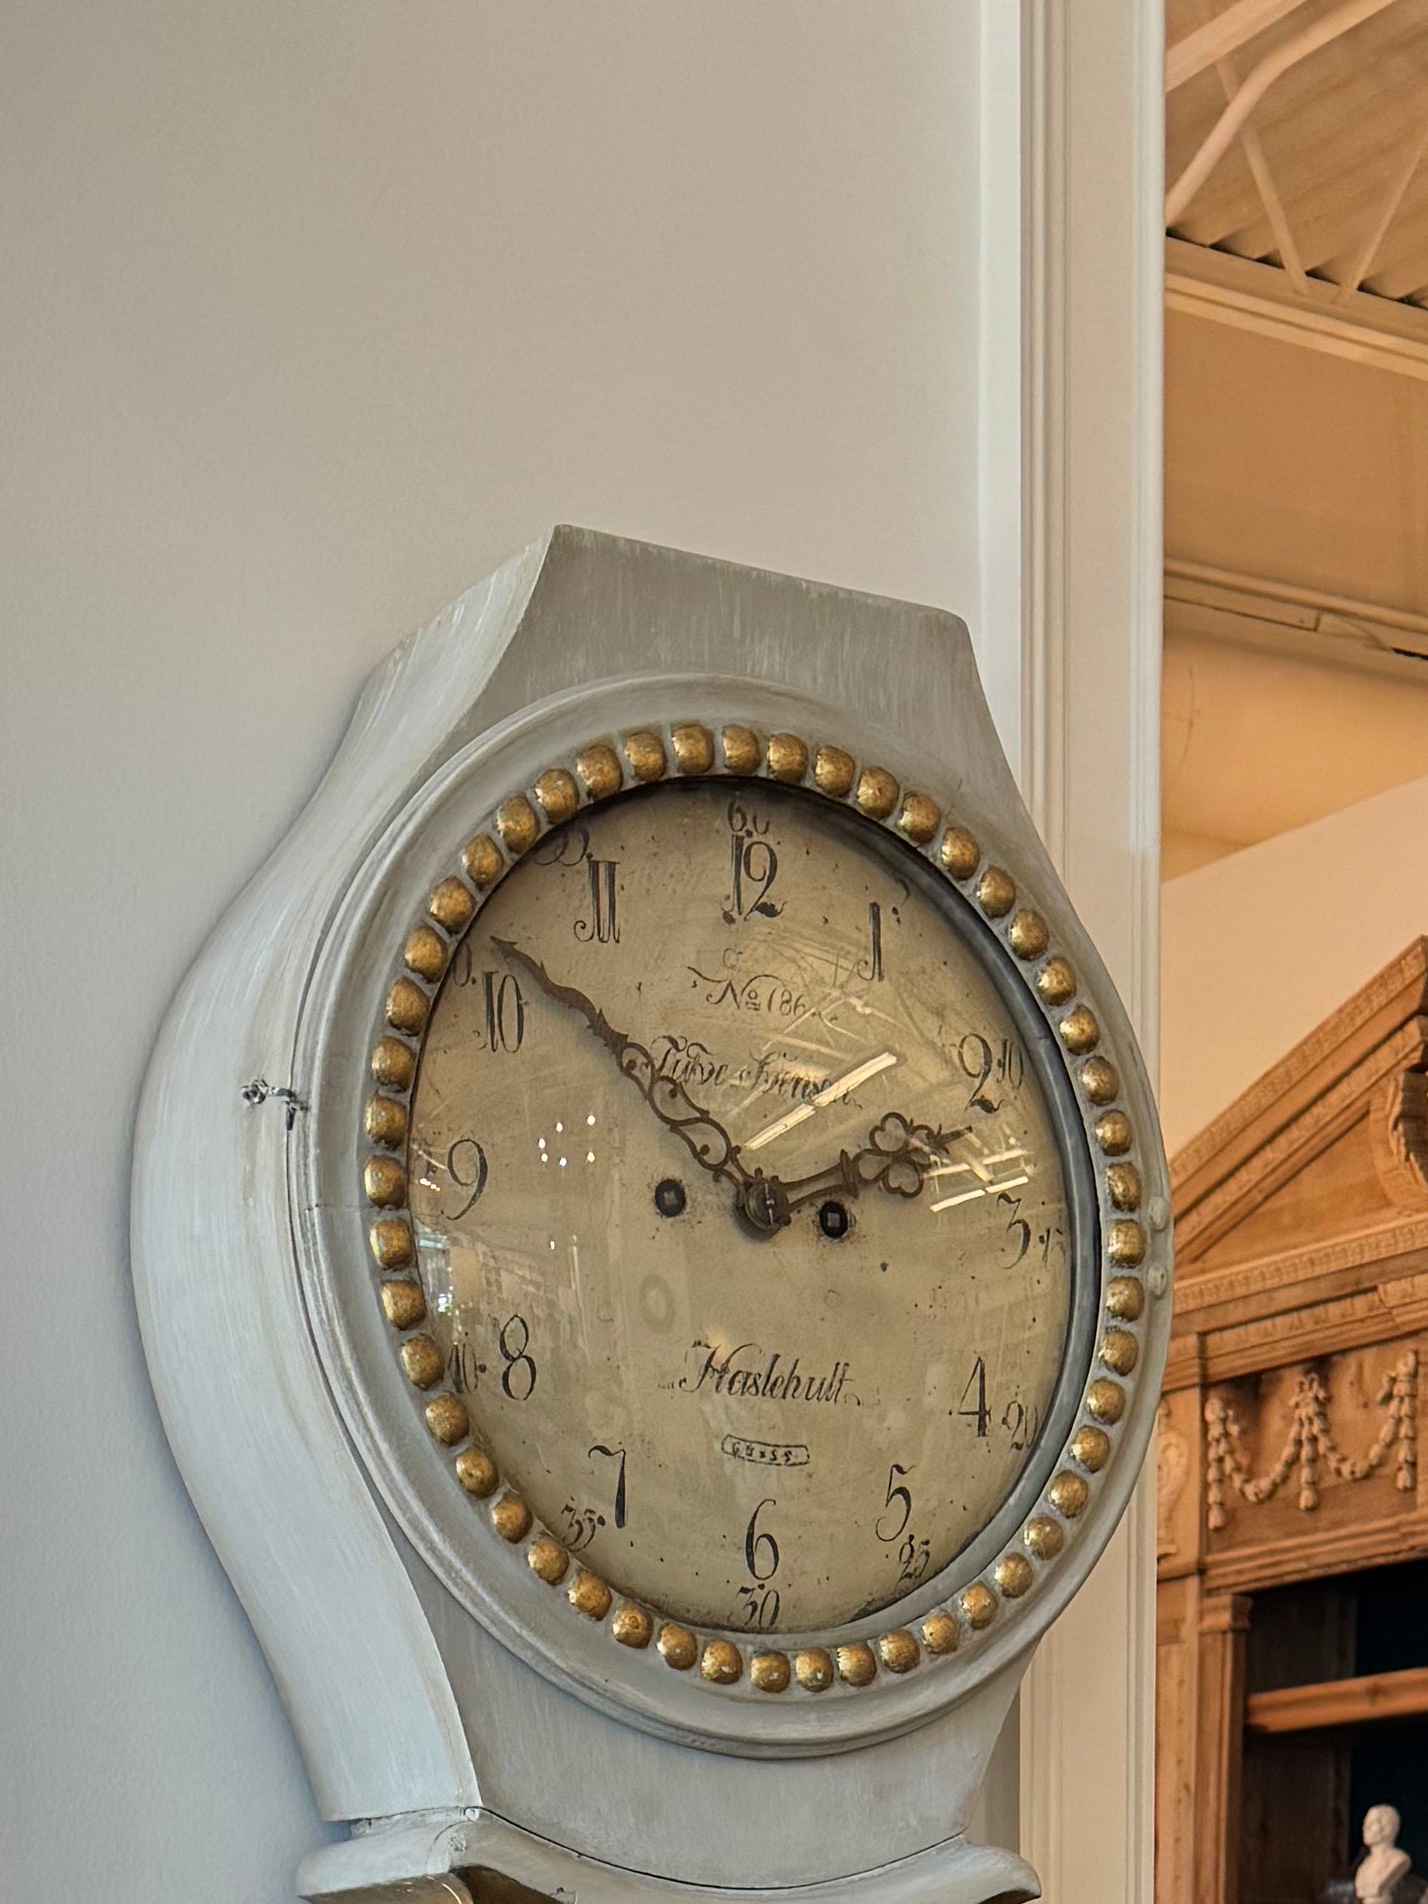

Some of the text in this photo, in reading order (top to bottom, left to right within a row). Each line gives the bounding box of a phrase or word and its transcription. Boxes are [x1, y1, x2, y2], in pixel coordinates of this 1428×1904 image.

[724, 834, 786, 924] 12
[481, 971, 524, 1053] 10
[958, 1033, 1004, 1113] 2
[447, 1138, 488, 1220] 9
[995, 1192, 1031, 1270] 3
[499, 1315, 536, 1400] 8
[957, 1356, 991, 1437] 4
[588, 1446, 626, 1529] 7
[875, 1464, 915, 1542] 5
[745, 1499, 779, 1580] 6
